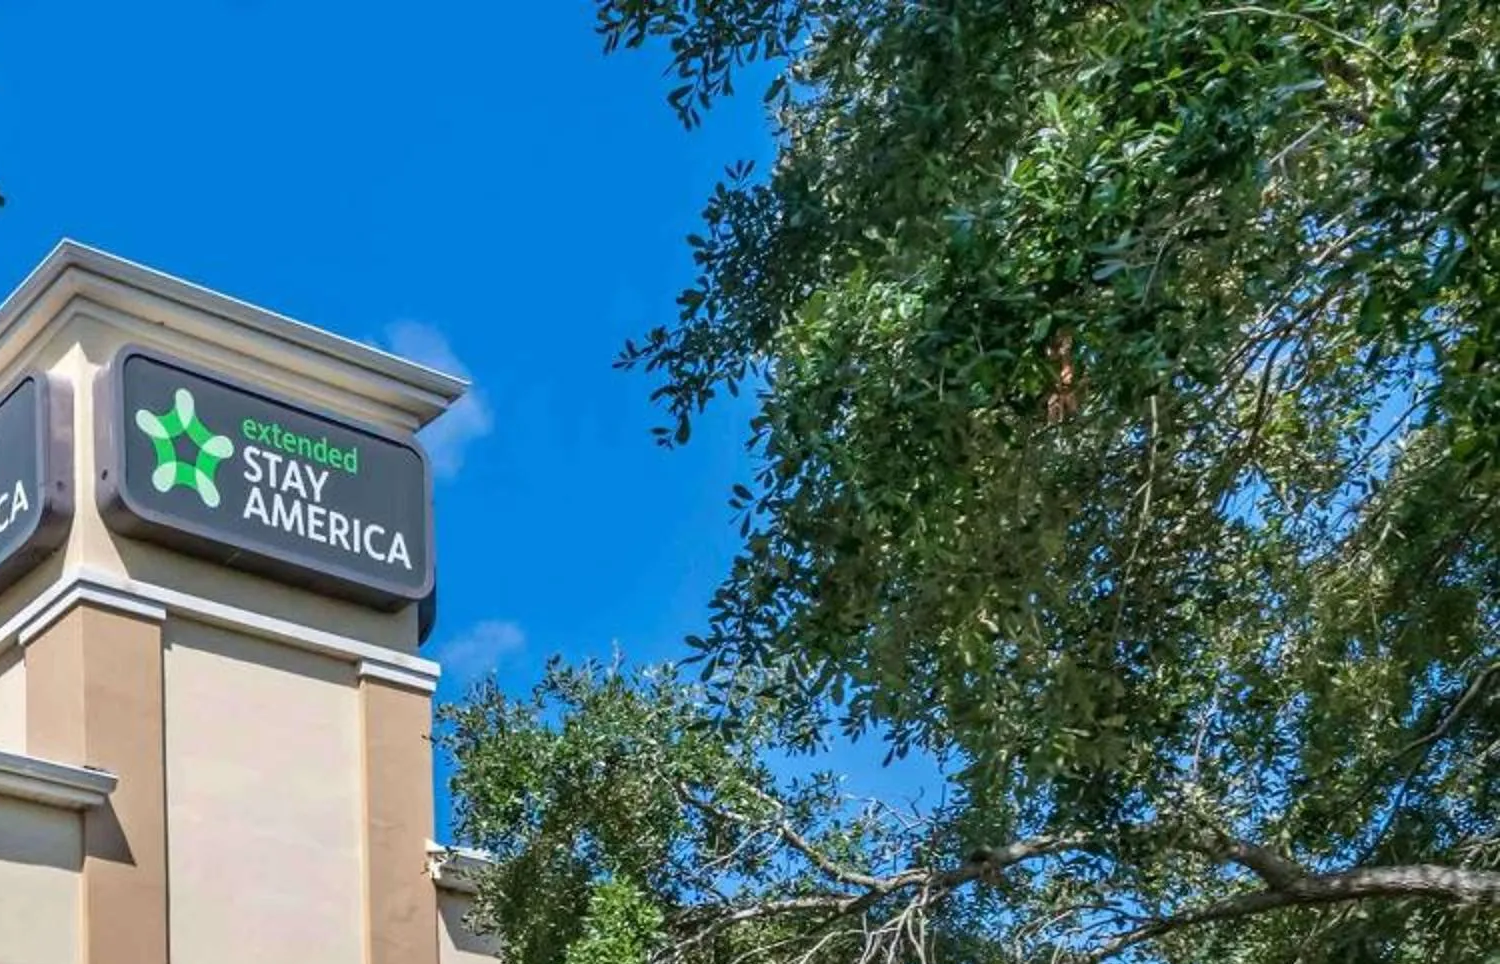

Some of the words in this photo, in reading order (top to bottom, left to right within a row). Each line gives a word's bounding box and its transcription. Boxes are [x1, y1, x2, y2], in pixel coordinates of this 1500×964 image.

[242, 418, 358, 474] extended
[243, 445, 330, 503] STAY
[242, 485, 412, 571] AMERICA
